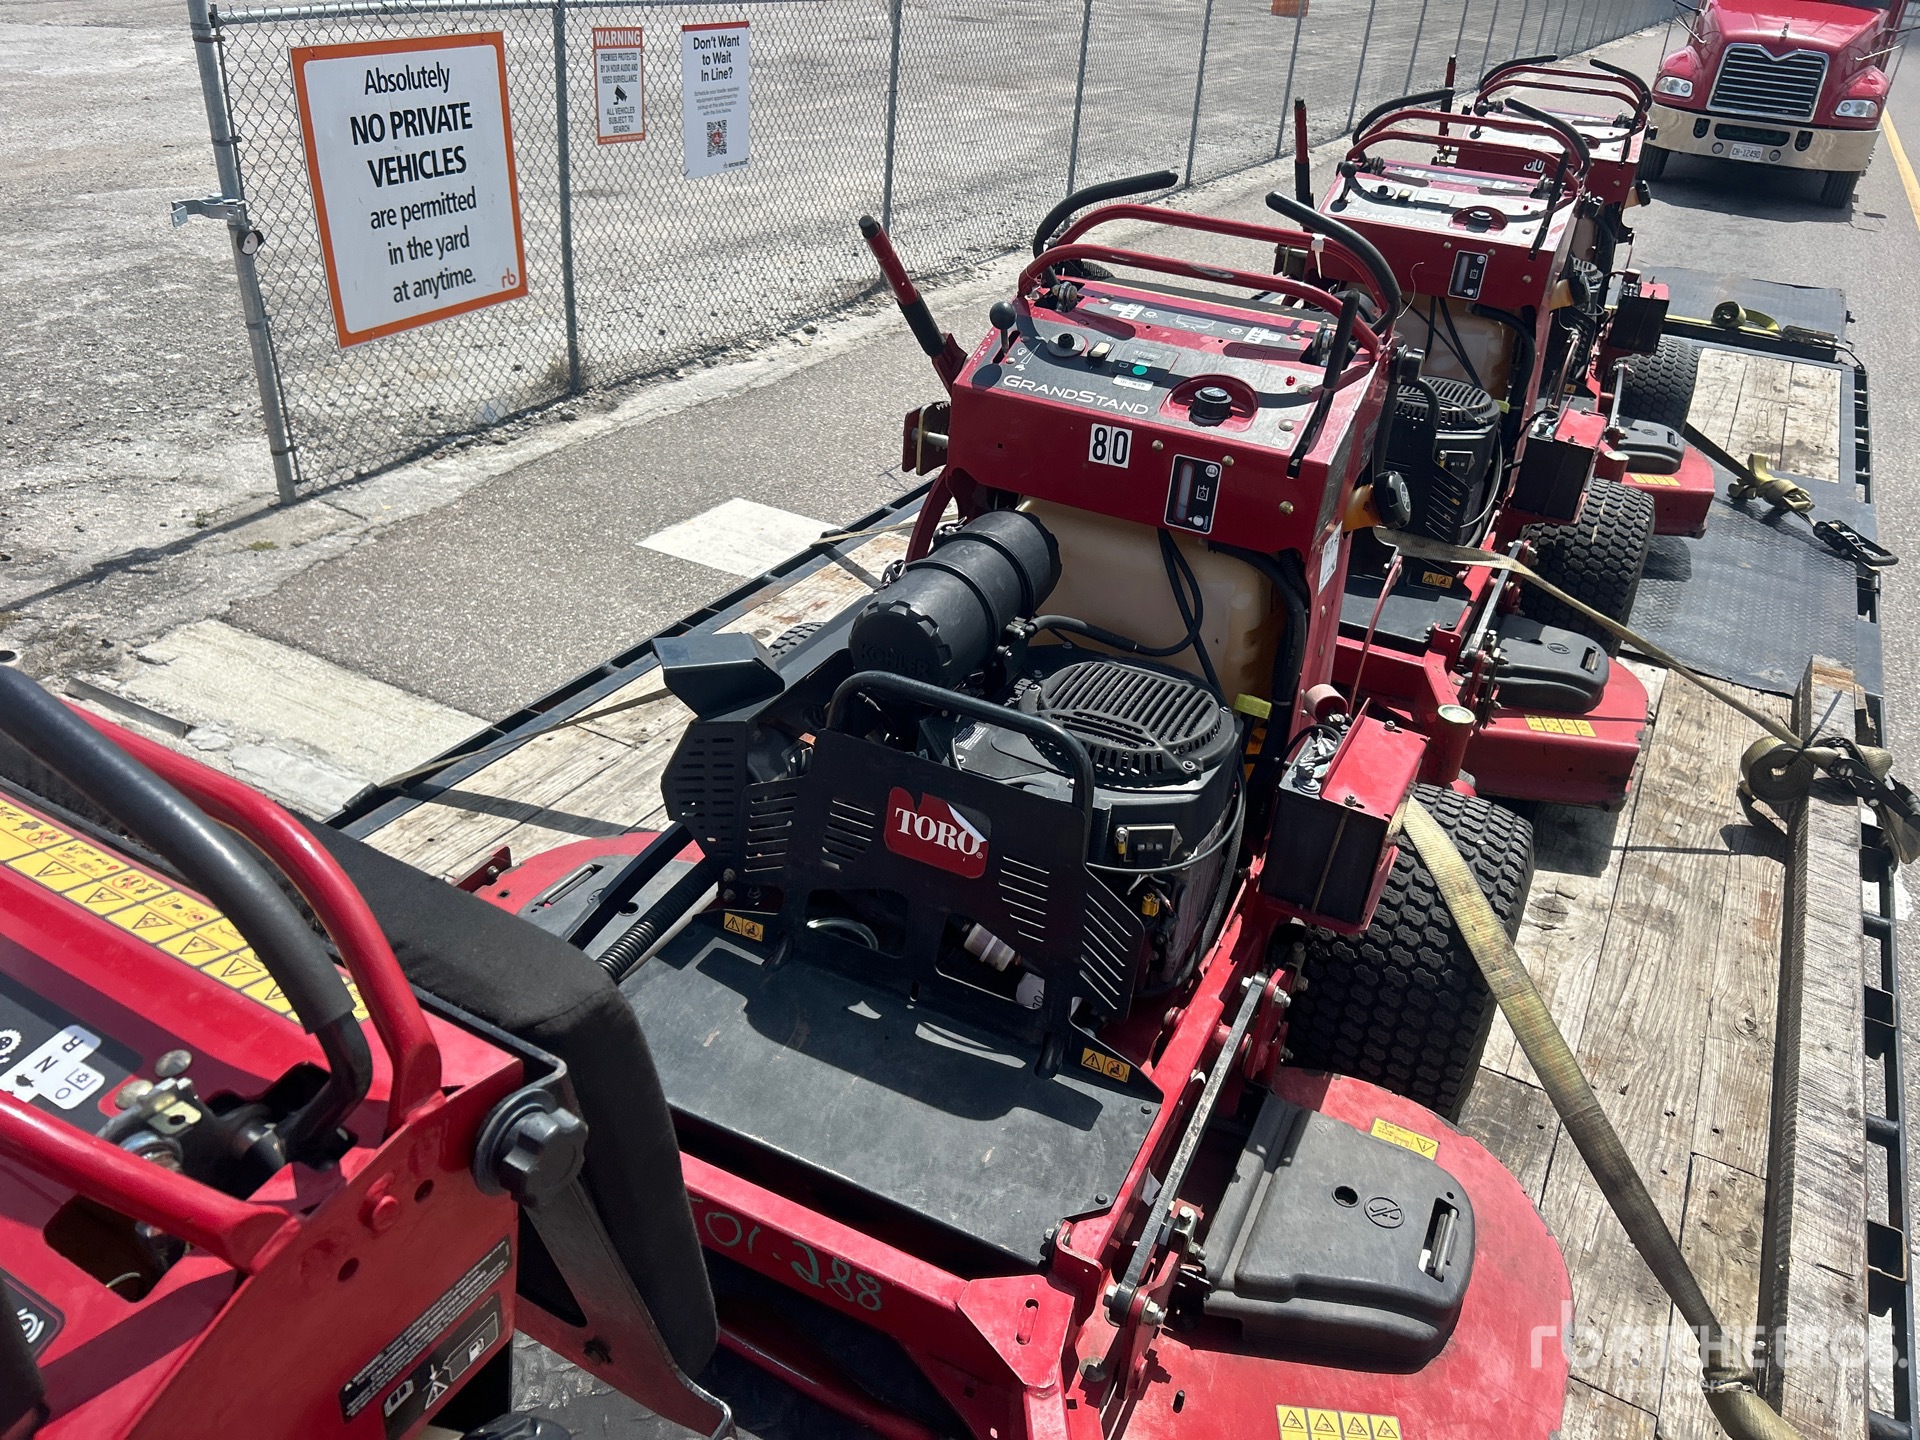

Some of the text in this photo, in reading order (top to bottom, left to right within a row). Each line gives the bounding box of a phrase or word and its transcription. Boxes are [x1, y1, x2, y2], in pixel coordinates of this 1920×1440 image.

[595, 30, 641, 47] WARNING
[693, 34, 740, 50] Don't Want
[701, 66, 734, 82] In Line?
[702, 50, 732, 66] to Wait
[364, 61, 450, 95] Absolutely
[350, 101, 473, 146] NO PRIVATE
[609, 116, 627, 125] SUBJECT
[615, 106, 635, 115] VEHICLES
[367, 145, 467, 188] VEHICLES
[370, 185, 477, 230] are permitted
[387, 224, 470, 266] in the yard
[393, 267, 476, 304] at anytime.
[501, 267, 517, 288] rb
[1003, 374, 1149, 415] GRANDSTAND
[1092, 427, 1129, 465] 80
[895, 807, 981, 856] TORO
